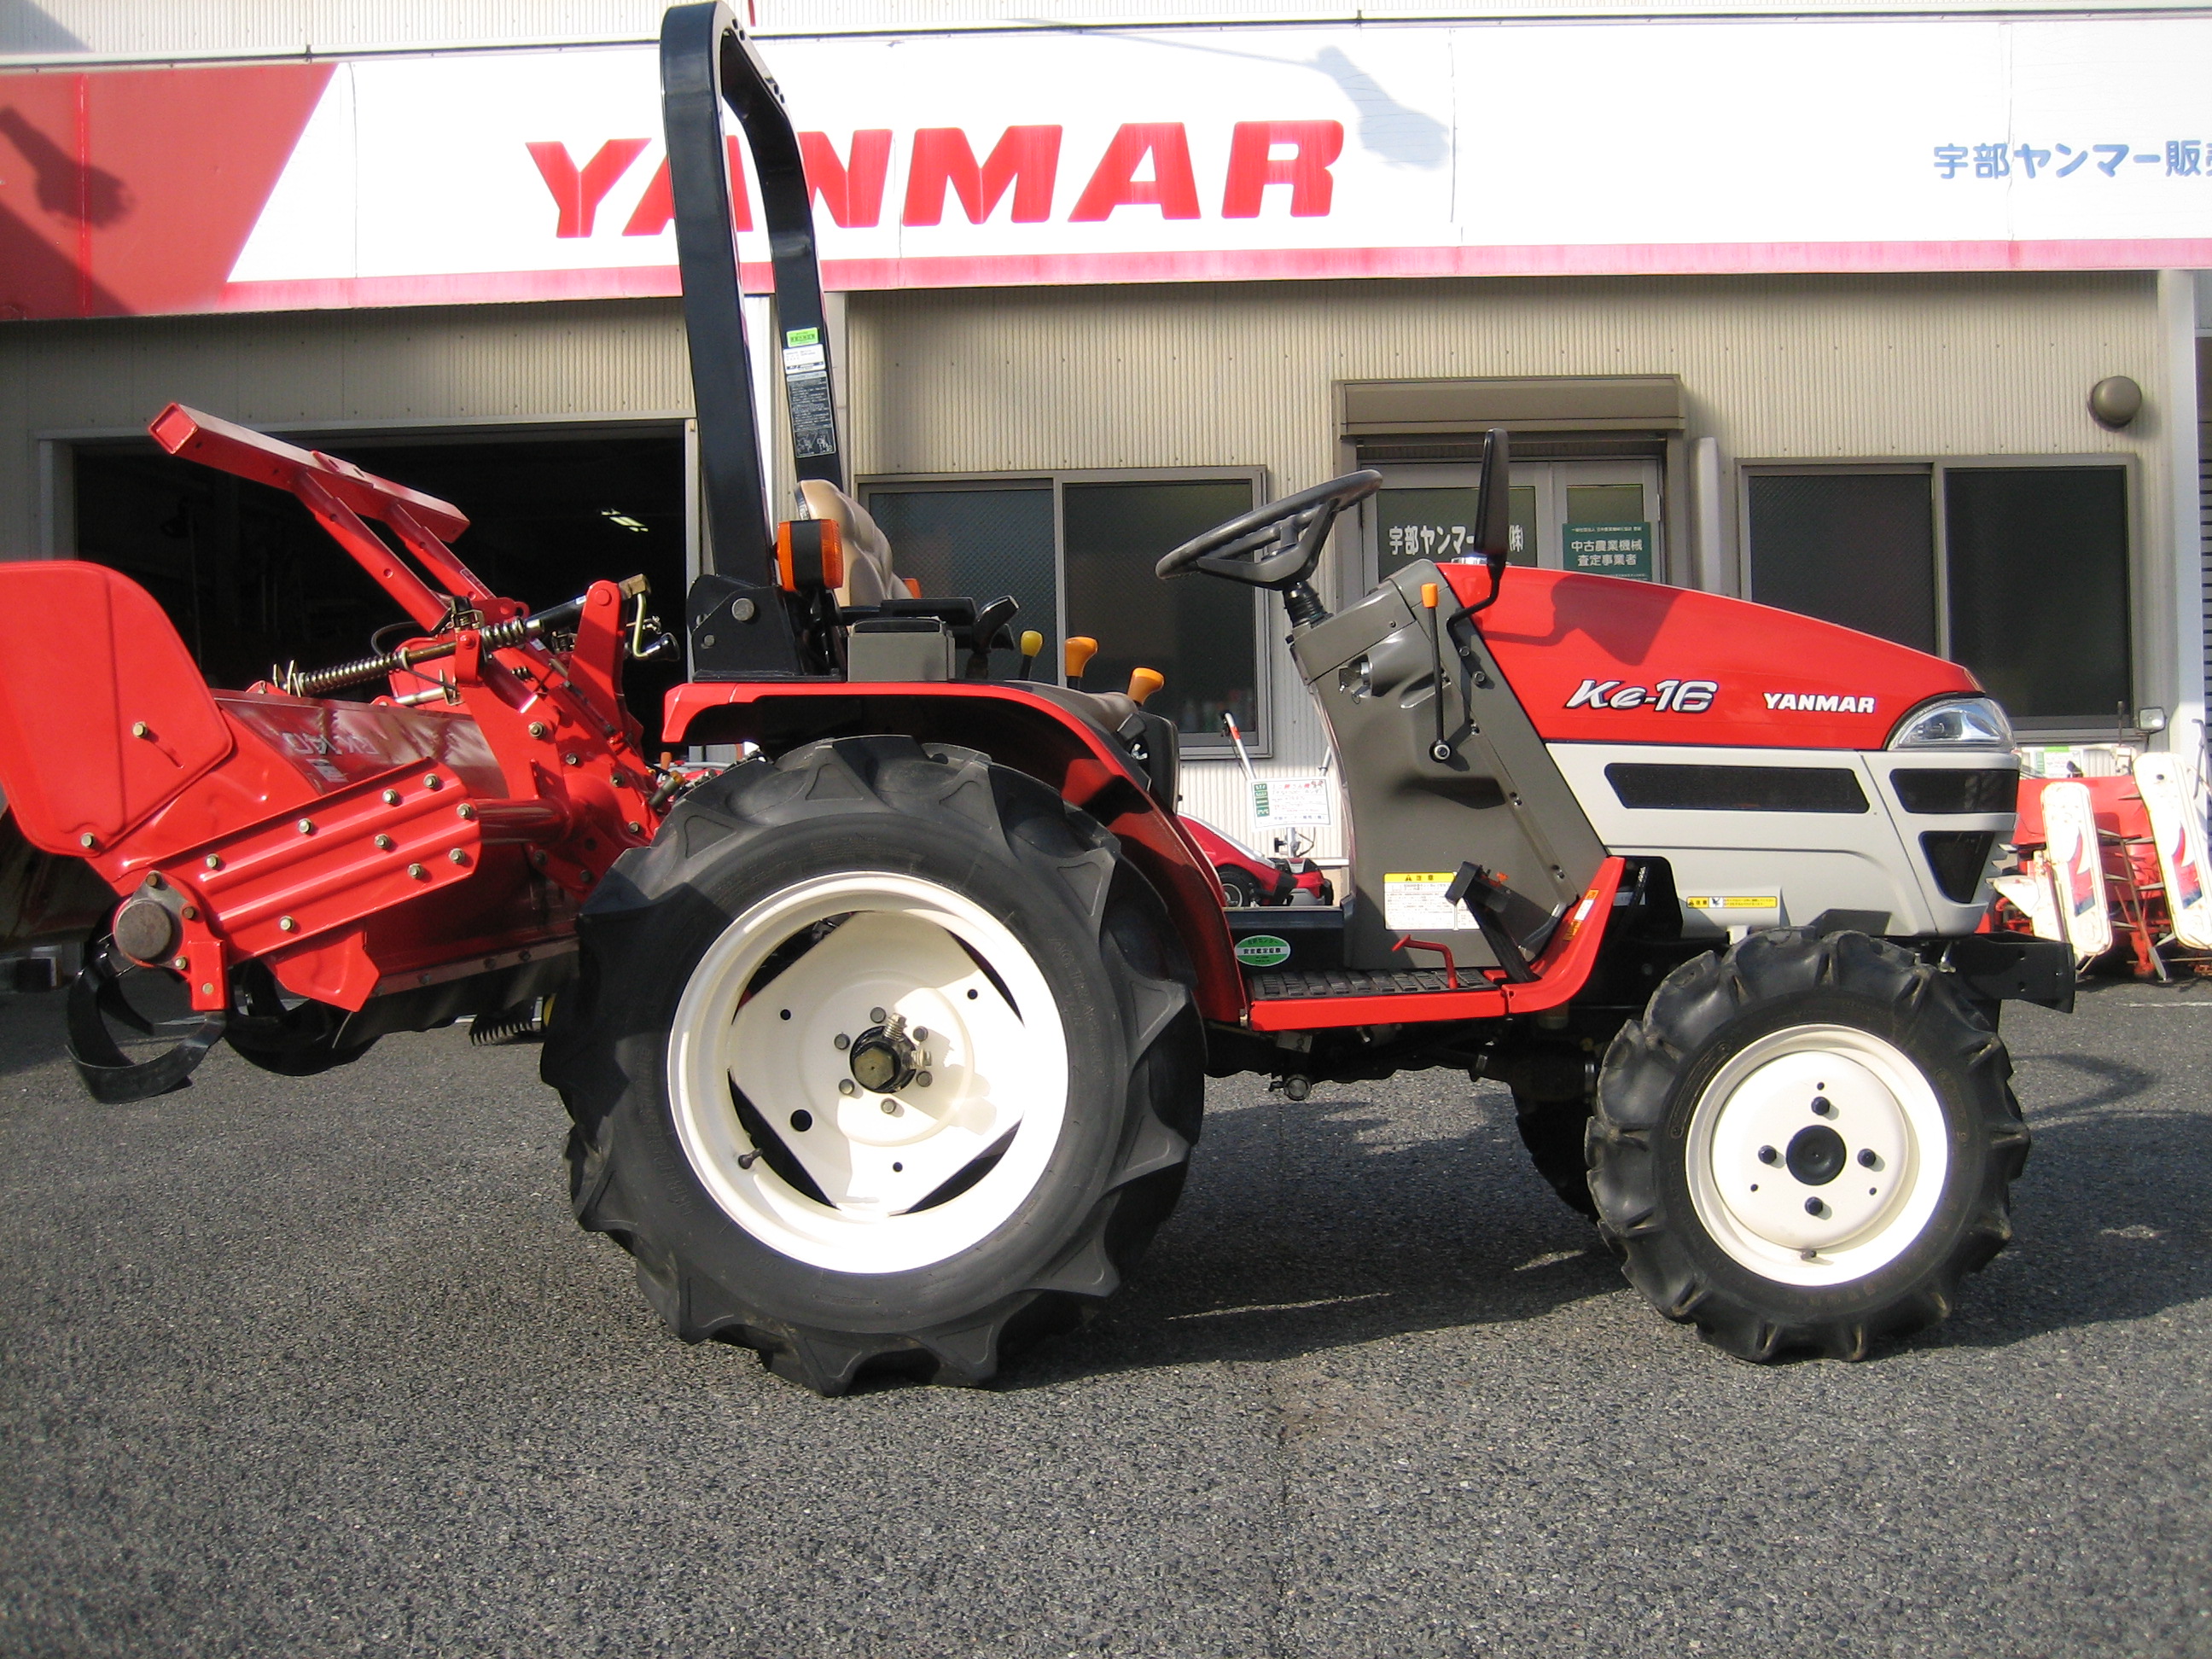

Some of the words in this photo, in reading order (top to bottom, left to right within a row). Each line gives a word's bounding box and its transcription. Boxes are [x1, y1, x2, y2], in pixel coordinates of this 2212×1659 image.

[1571, 539, 1643, 552] 中古農業機械
[1578, 554, 1637, 567] 査定事業者
[1565, 679, 1718, 713] Ke-16
[1763, 692, 1876, 713] YANMAR
